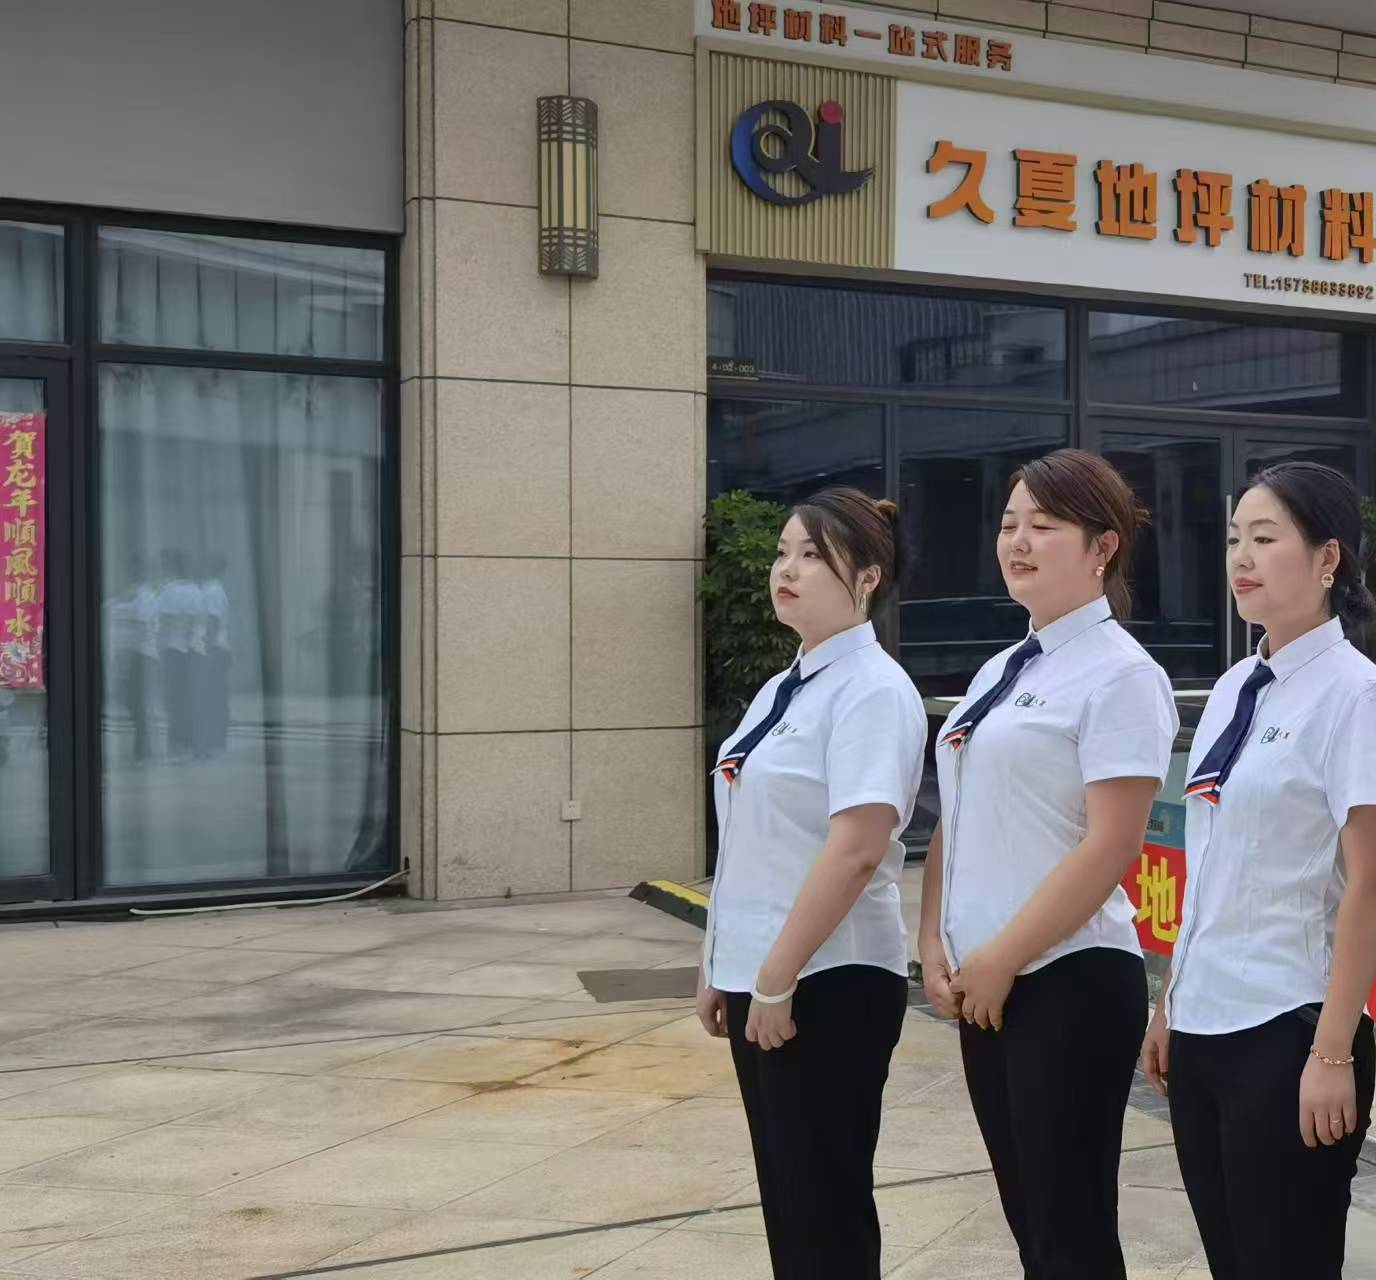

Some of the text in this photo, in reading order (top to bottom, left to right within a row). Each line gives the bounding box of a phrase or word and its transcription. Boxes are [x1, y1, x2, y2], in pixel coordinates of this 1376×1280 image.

[711, 0, 1013, 71] 地坪材料一站式服务
